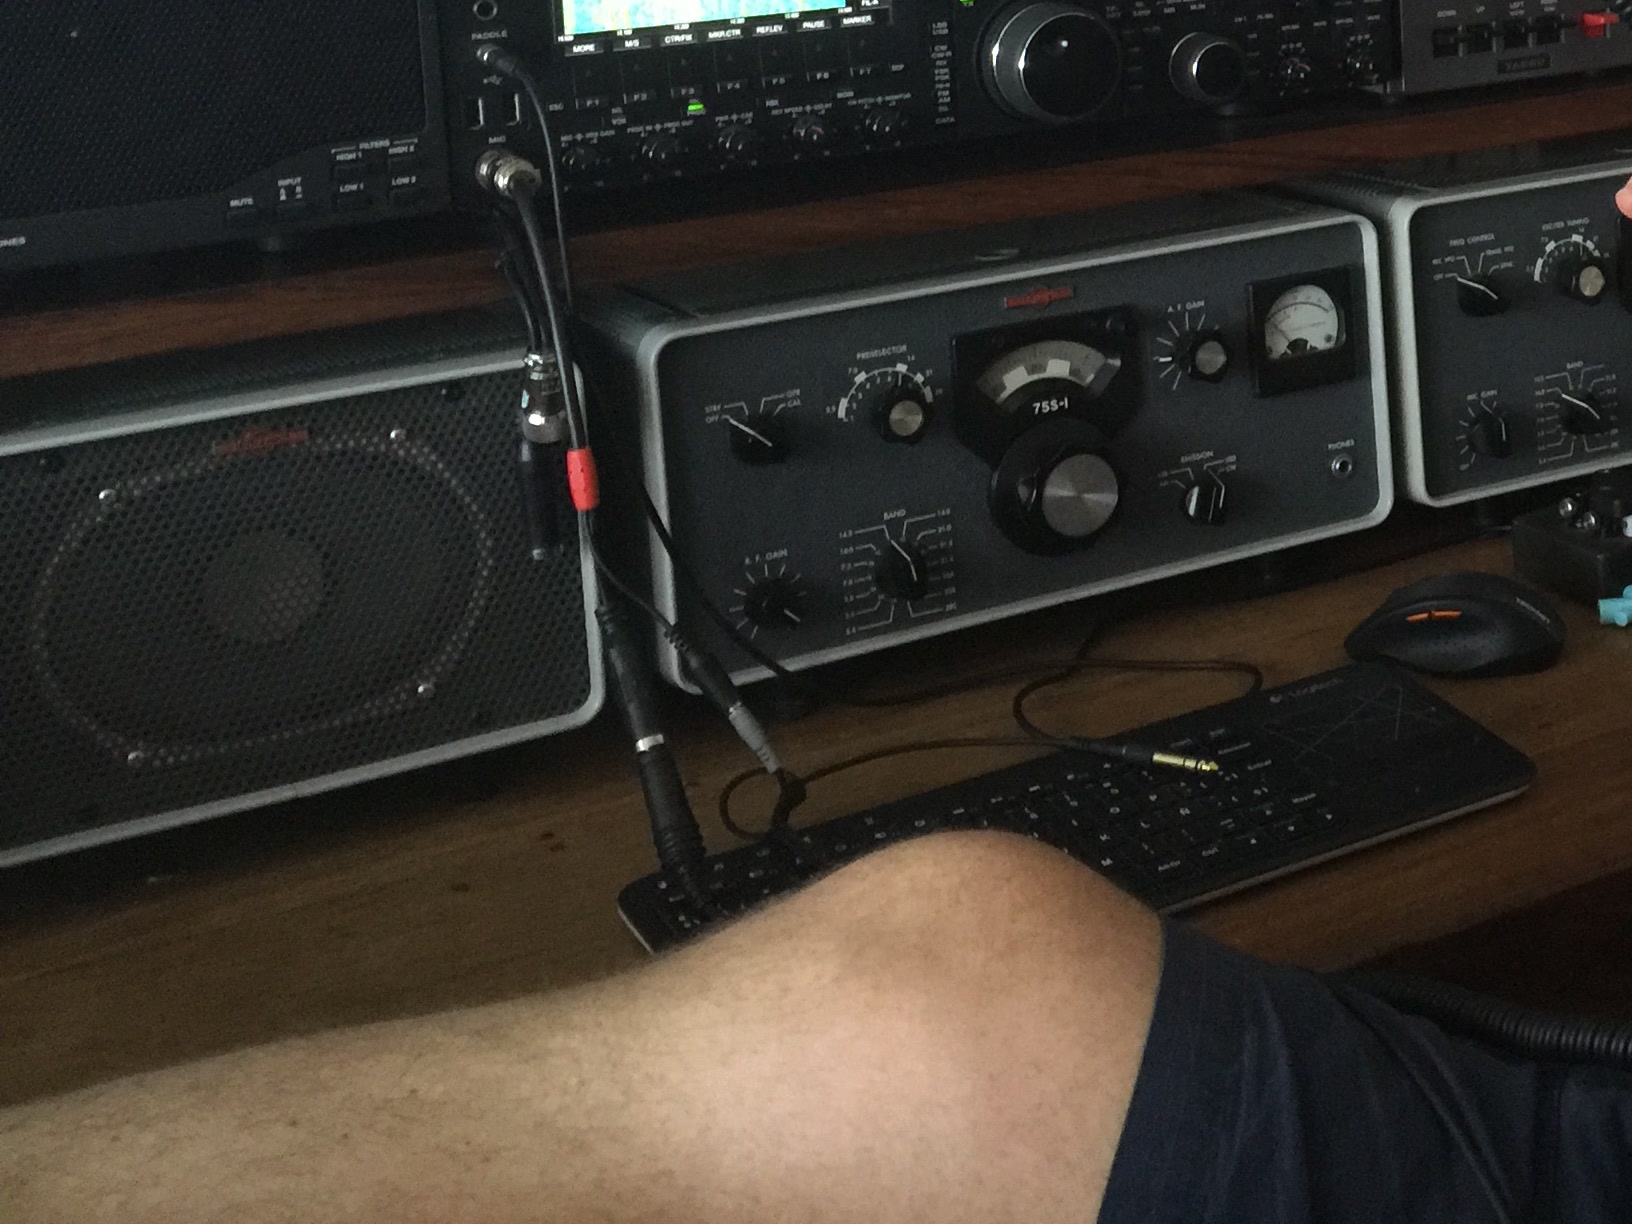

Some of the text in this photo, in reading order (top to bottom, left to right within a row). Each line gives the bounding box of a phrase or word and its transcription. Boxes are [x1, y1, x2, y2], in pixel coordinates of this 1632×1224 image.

[802, 19, 826, 29] PAUSE
[842, 14, 872, 25] MARKER
[471, 29, 508, 41] PADDLE
[572, 43, 596, 54] MORE
[229, 197, 254, 208] MUTE
[856, 344, 908, 361] PRESELECTOR
[1032, 396, 1069, 416] 75S-1
[705, 414, 719, 424] OFF
[883, 508, 907, 521] BAND
[765, 548, 788, 560] GAIN
